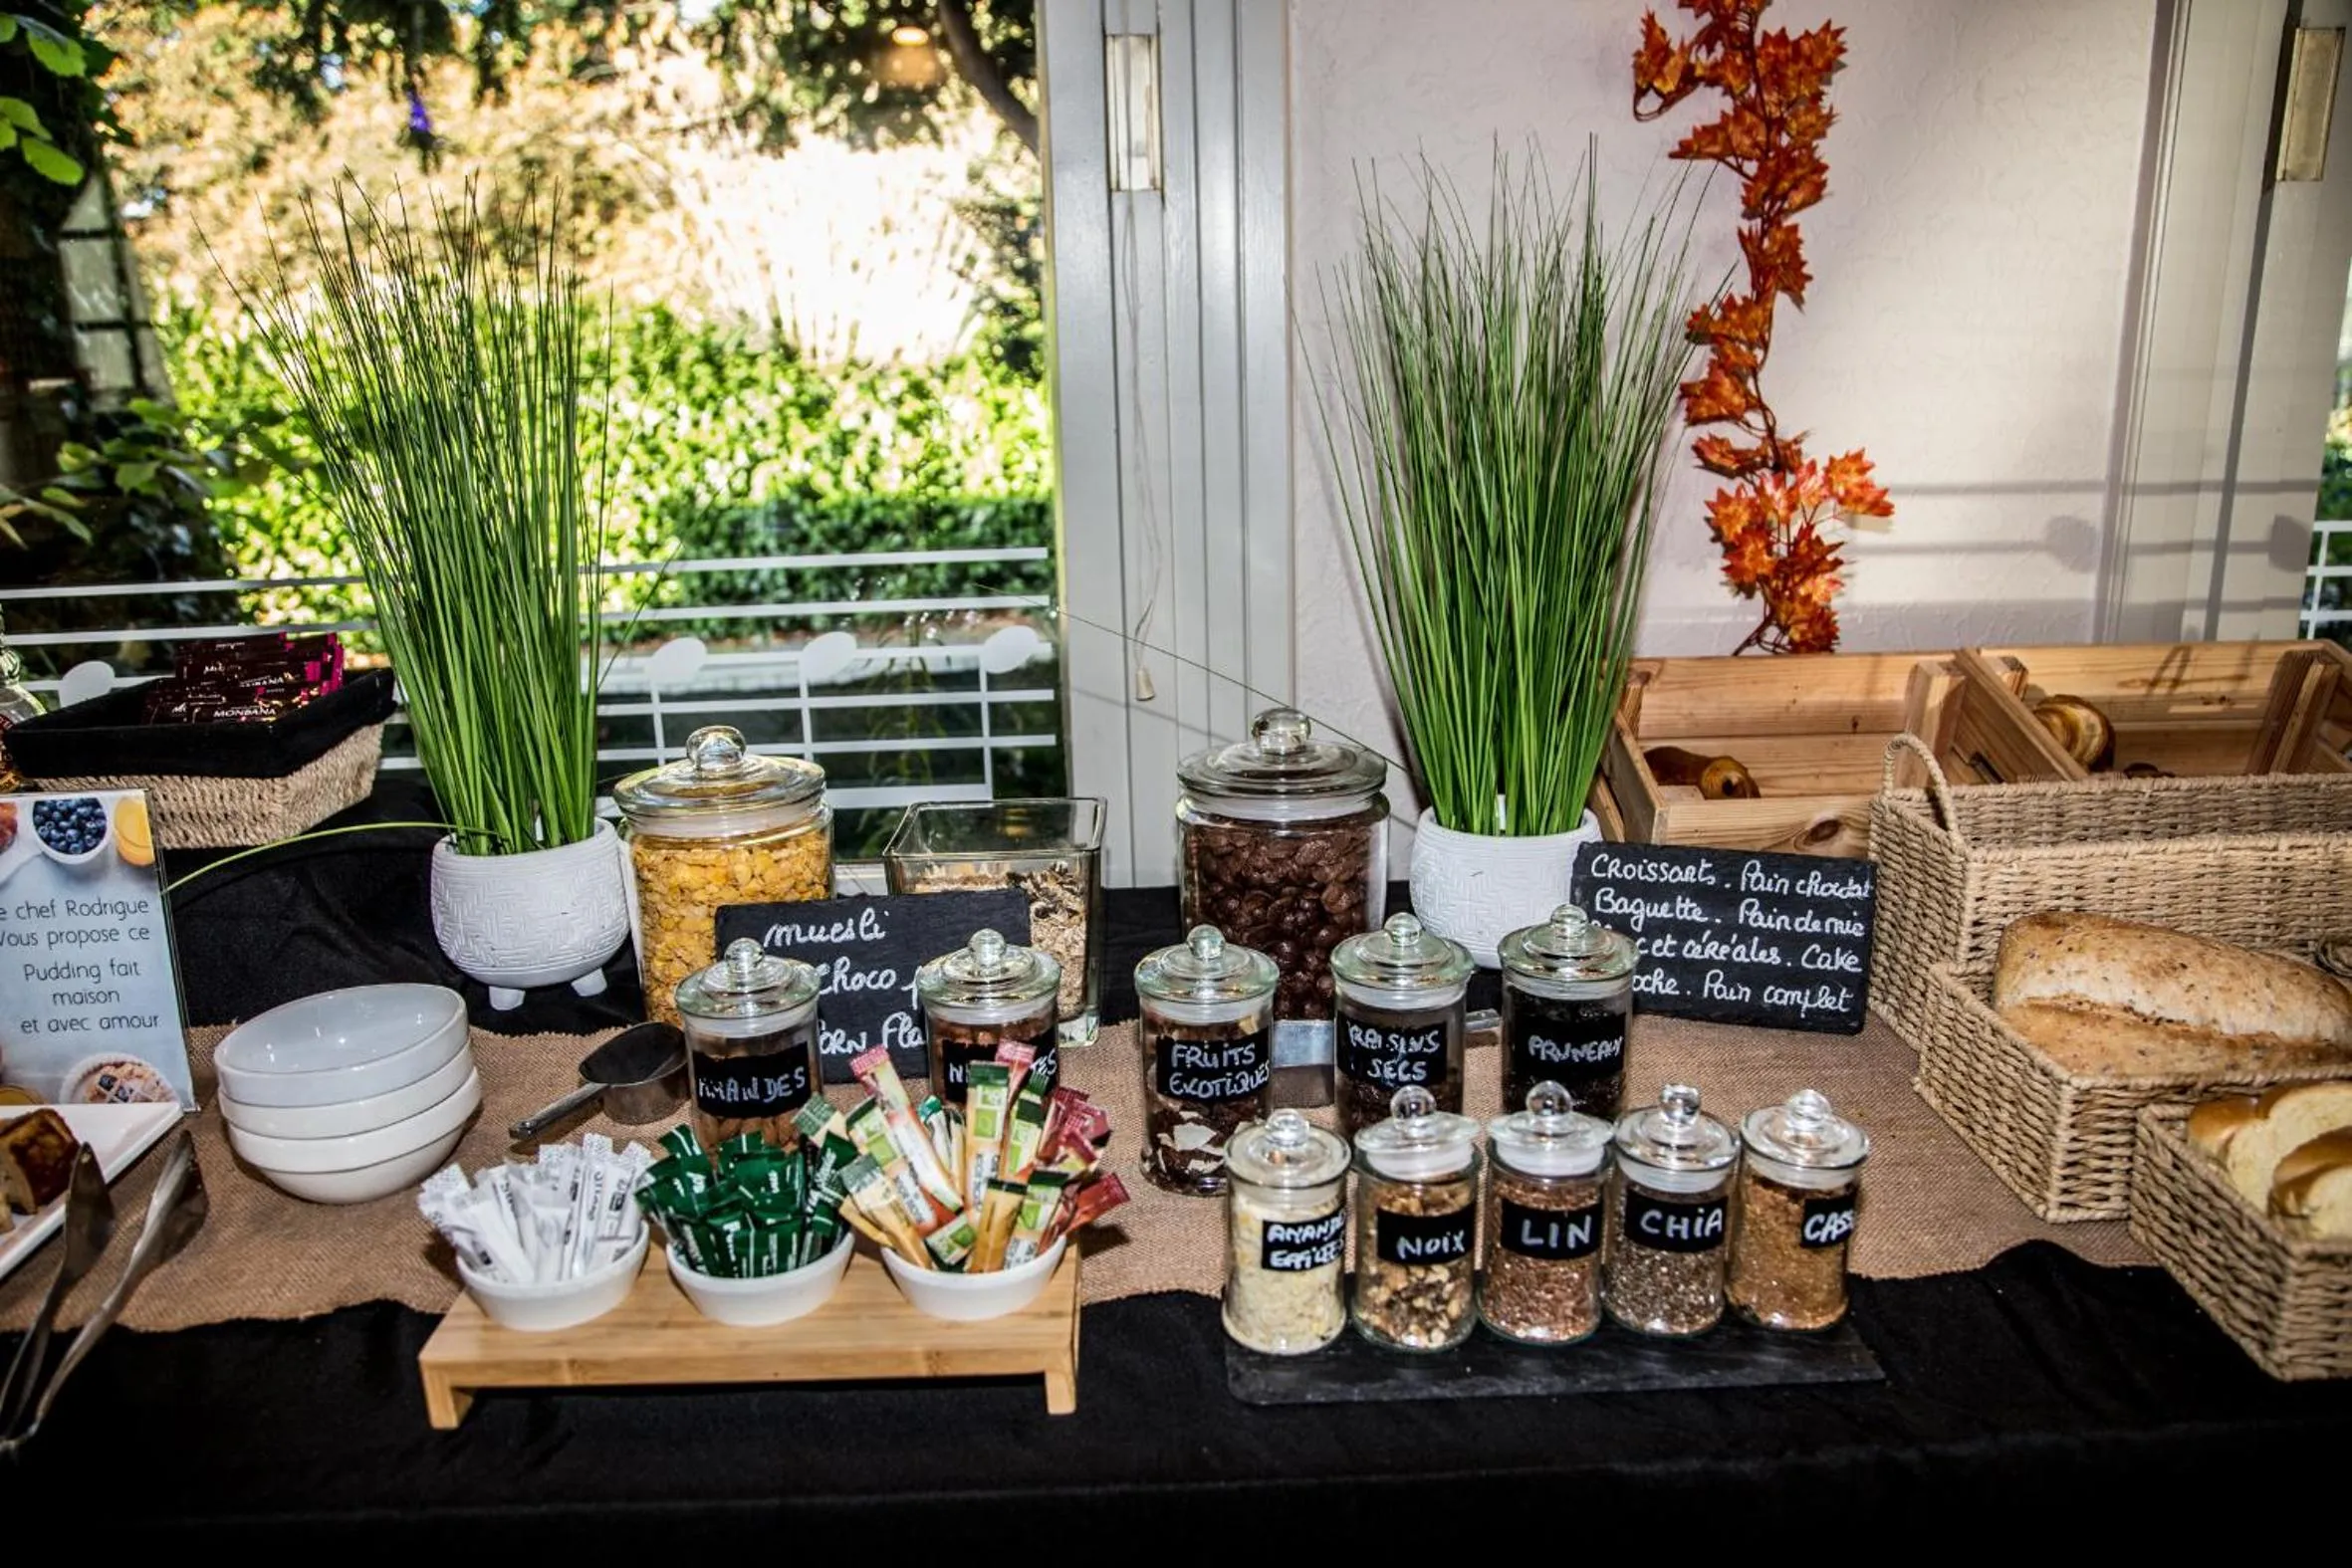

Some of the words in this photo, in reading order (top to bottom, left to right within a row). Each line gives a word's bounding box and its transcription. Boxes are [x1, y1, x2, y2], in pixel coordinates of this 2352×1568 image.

[1741, 859, 1789, 895] Pain
[16, 899, 56, 920] chef
[66, 898, 149, 921] Rodrigue
[1739, 898, 1791, 931] Pain
[48, 927, 119, 950] propose
[128, 927, 150, 941] ce
[763, 907, 890, 947] muesli
[23, 961, 102, 984] Pudding
[110, 958, 141, 977] fait
[52, 990, 120, 1007] maison
[1704, 969, 1752, 1004] Pain
[1764, 986, 1854, 1019] complet
[20, 1017, 40, 1034] et
[47, 1016, 93, 1032] avec
[100, 1014, 160, 1030] amour
[1367, 1057, 1428, 1083] SECS
[1521, 1215, 1592, 1249] LIN
